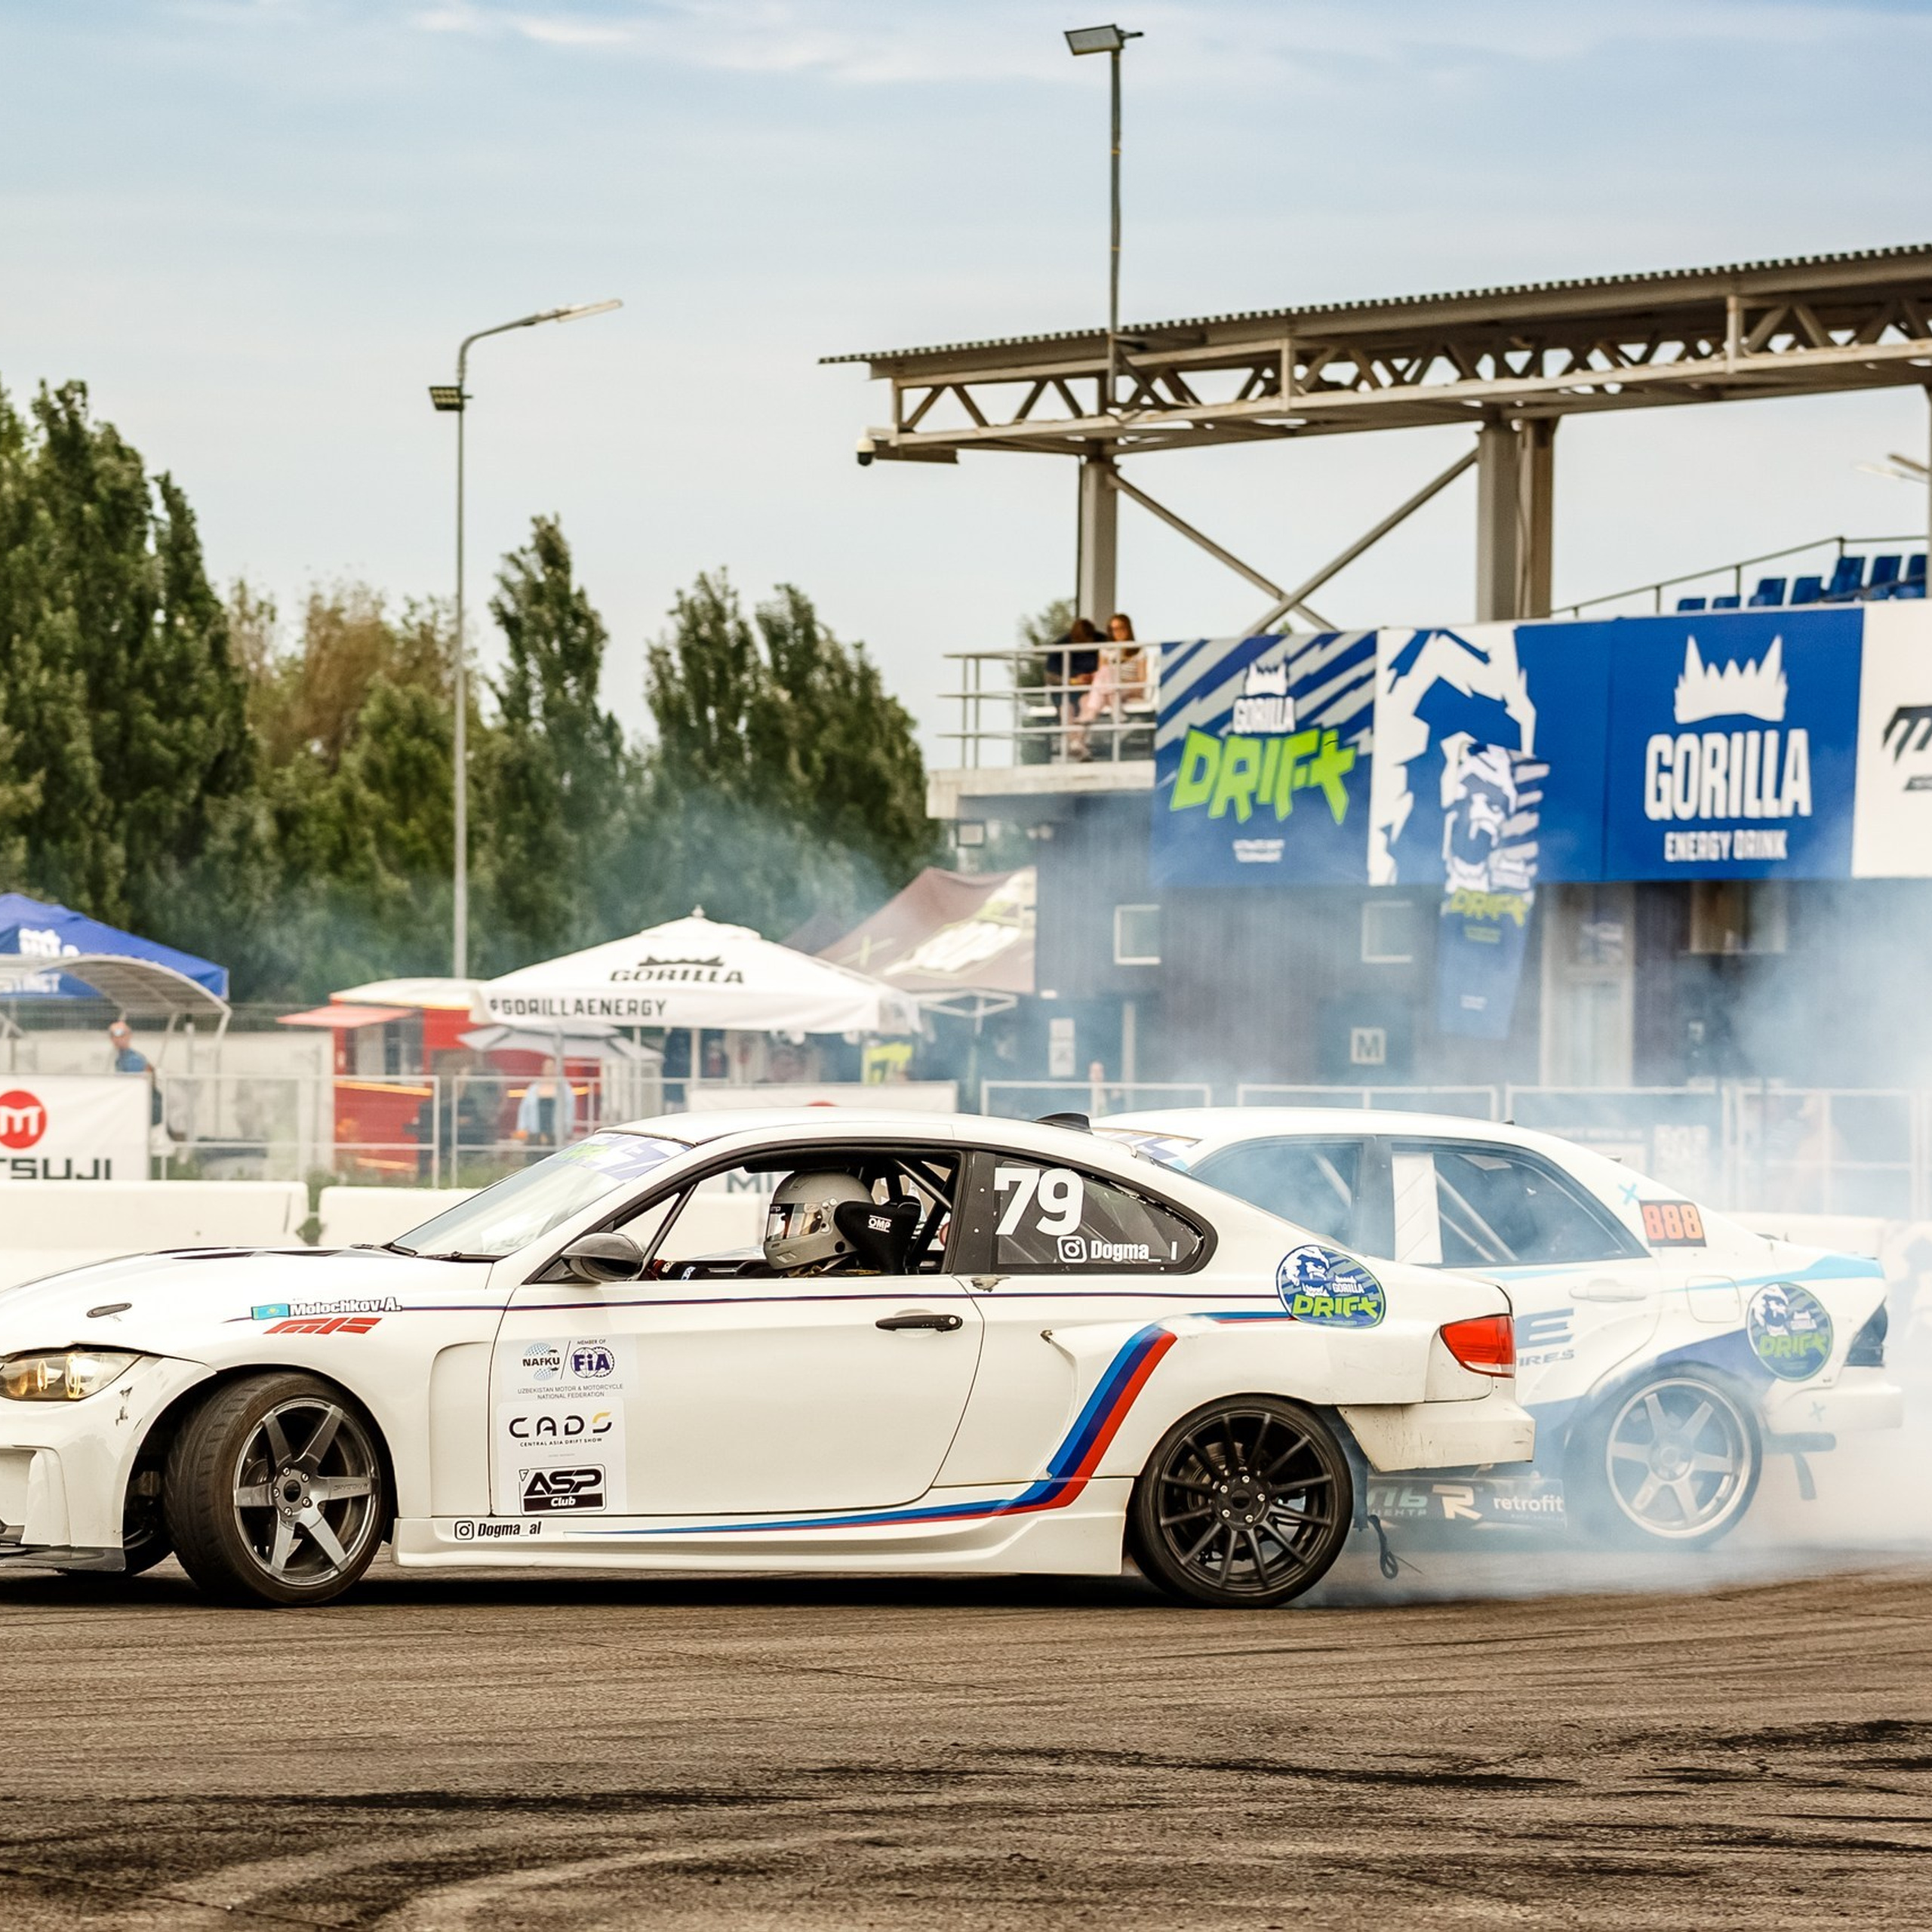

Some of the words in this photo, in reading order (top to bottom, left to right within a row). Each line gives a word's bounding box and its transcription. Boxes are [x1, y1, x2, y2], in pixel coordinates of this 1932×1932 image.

[1644, 728, 1813, 821] GORILLA
[1664, 830, 1733, 863] ENERGY
[1733, 829, 1789, 860] DRINK
[610, 968, 744, 984] GORILLA
[0, 1158, 112, 1180] SUJI
[994, 1167, 1084, 1235] 79
[868, 1217, 892, 1230] OMP
[1642, 1204, 1703, 1240] 888
[1331, 1282, 1365, 1294] GORILLA
[289, 1300, 382, 1316] Molochkov
[522, 1356, 561, 1367] NAFKU
[1518, 1349, 1574, 1367] IRES
[517, 1386, 554, 1394] UZBEKISTAN
[509, 1411, 613, 1438] CADS
[523, 1468, 602, 1497] ASP
[550, 1496, 577, 1507] Club
[1493, 1494, 1564, 1512] retrofit
[477, 1521, 542, 1538] Dogma_al
